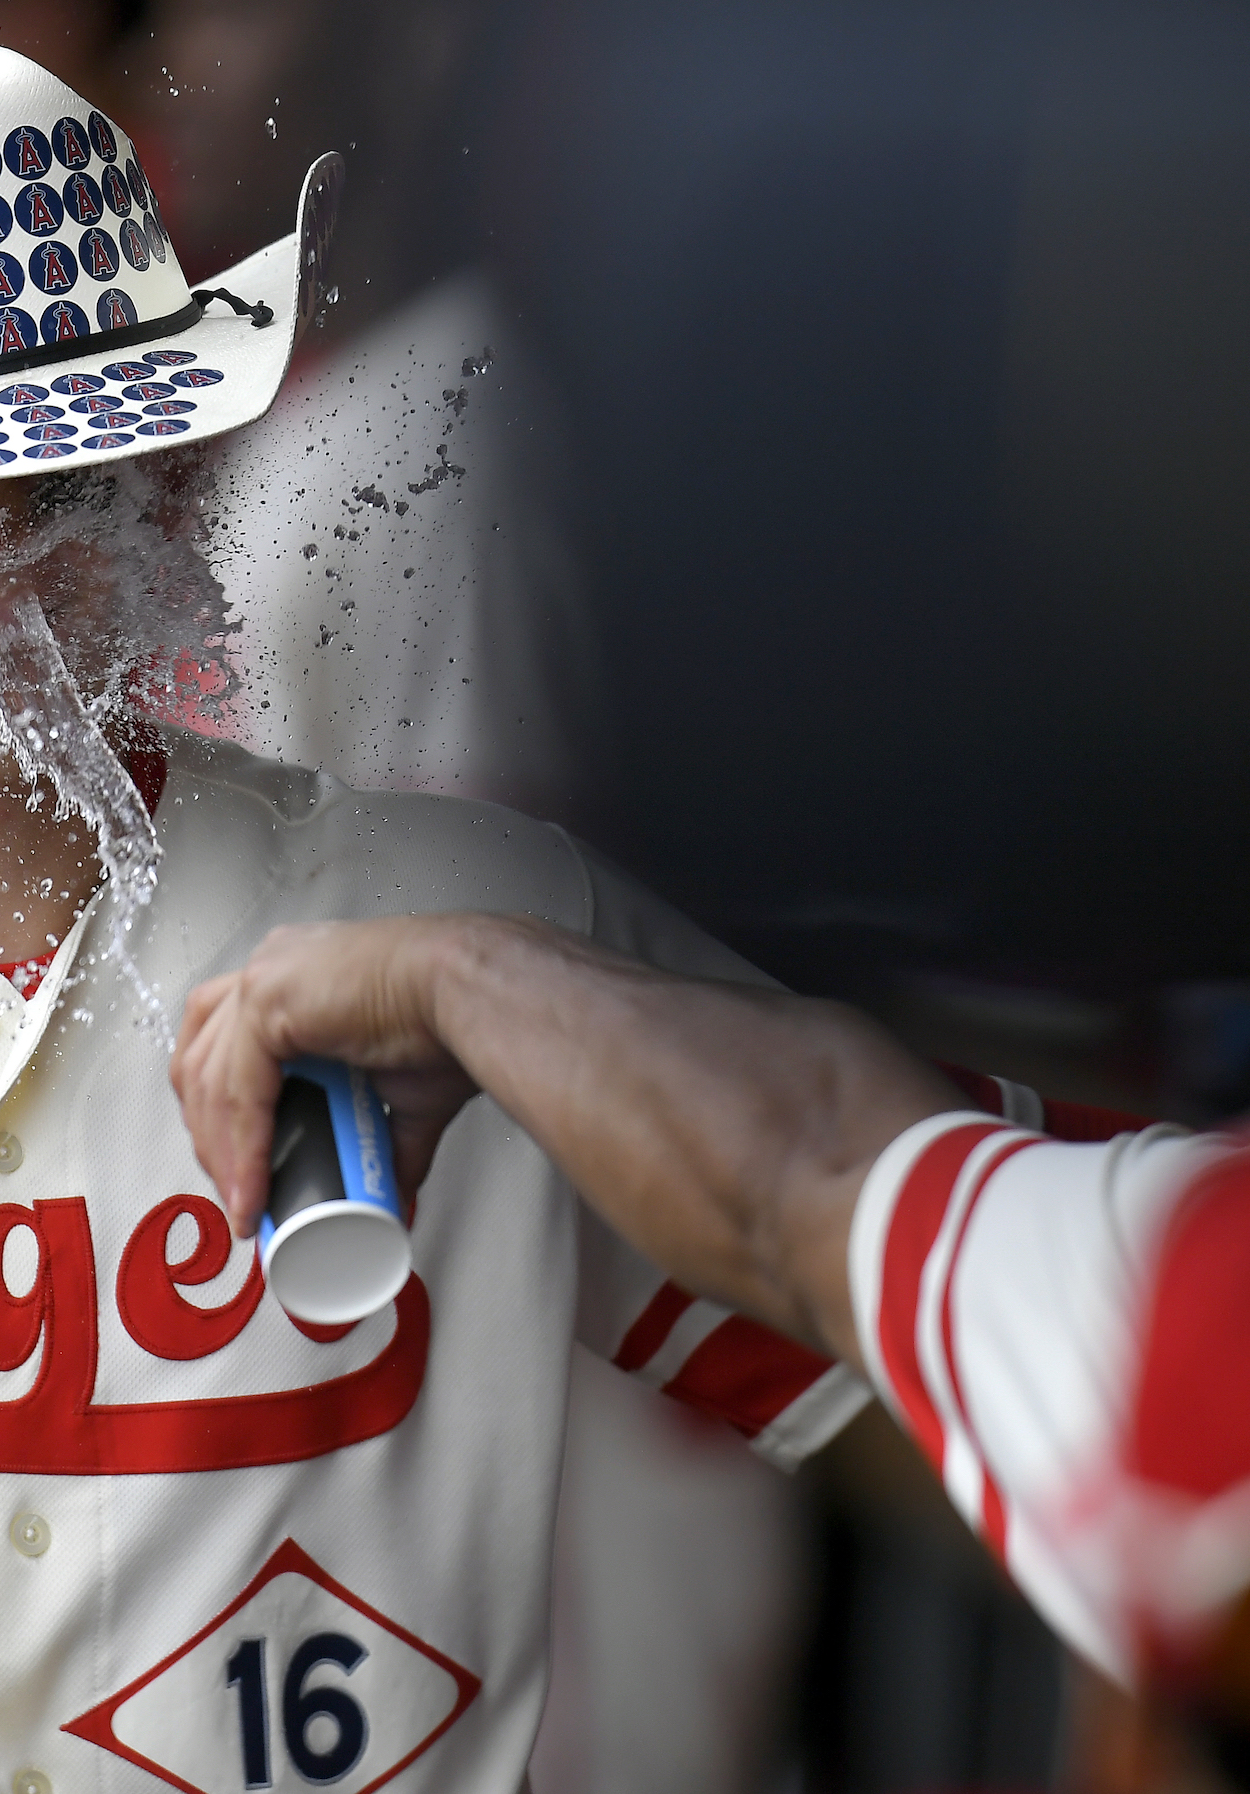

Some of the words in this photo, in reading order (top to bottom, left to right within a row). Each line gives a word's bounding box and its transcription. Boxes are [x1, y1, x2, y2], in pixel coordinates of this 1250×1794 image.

[17, 128, 46, 175] A
[60, 119, 87, 166] A
[92, 112, 116, 158] A
[26, 185, 58, 232] A
[73, 175, 99, 221] A
[107, 166, 130, 214] A
[88, 230, 115, 276] A
[125, 220, 149, 267] A
[147, 215, 165, 258] A
[41, 243, 71, 290] A
[53, 303, 79, 342] A
[106, 290, 130, 329] A
[224, 1631, 370, 1790] 16
